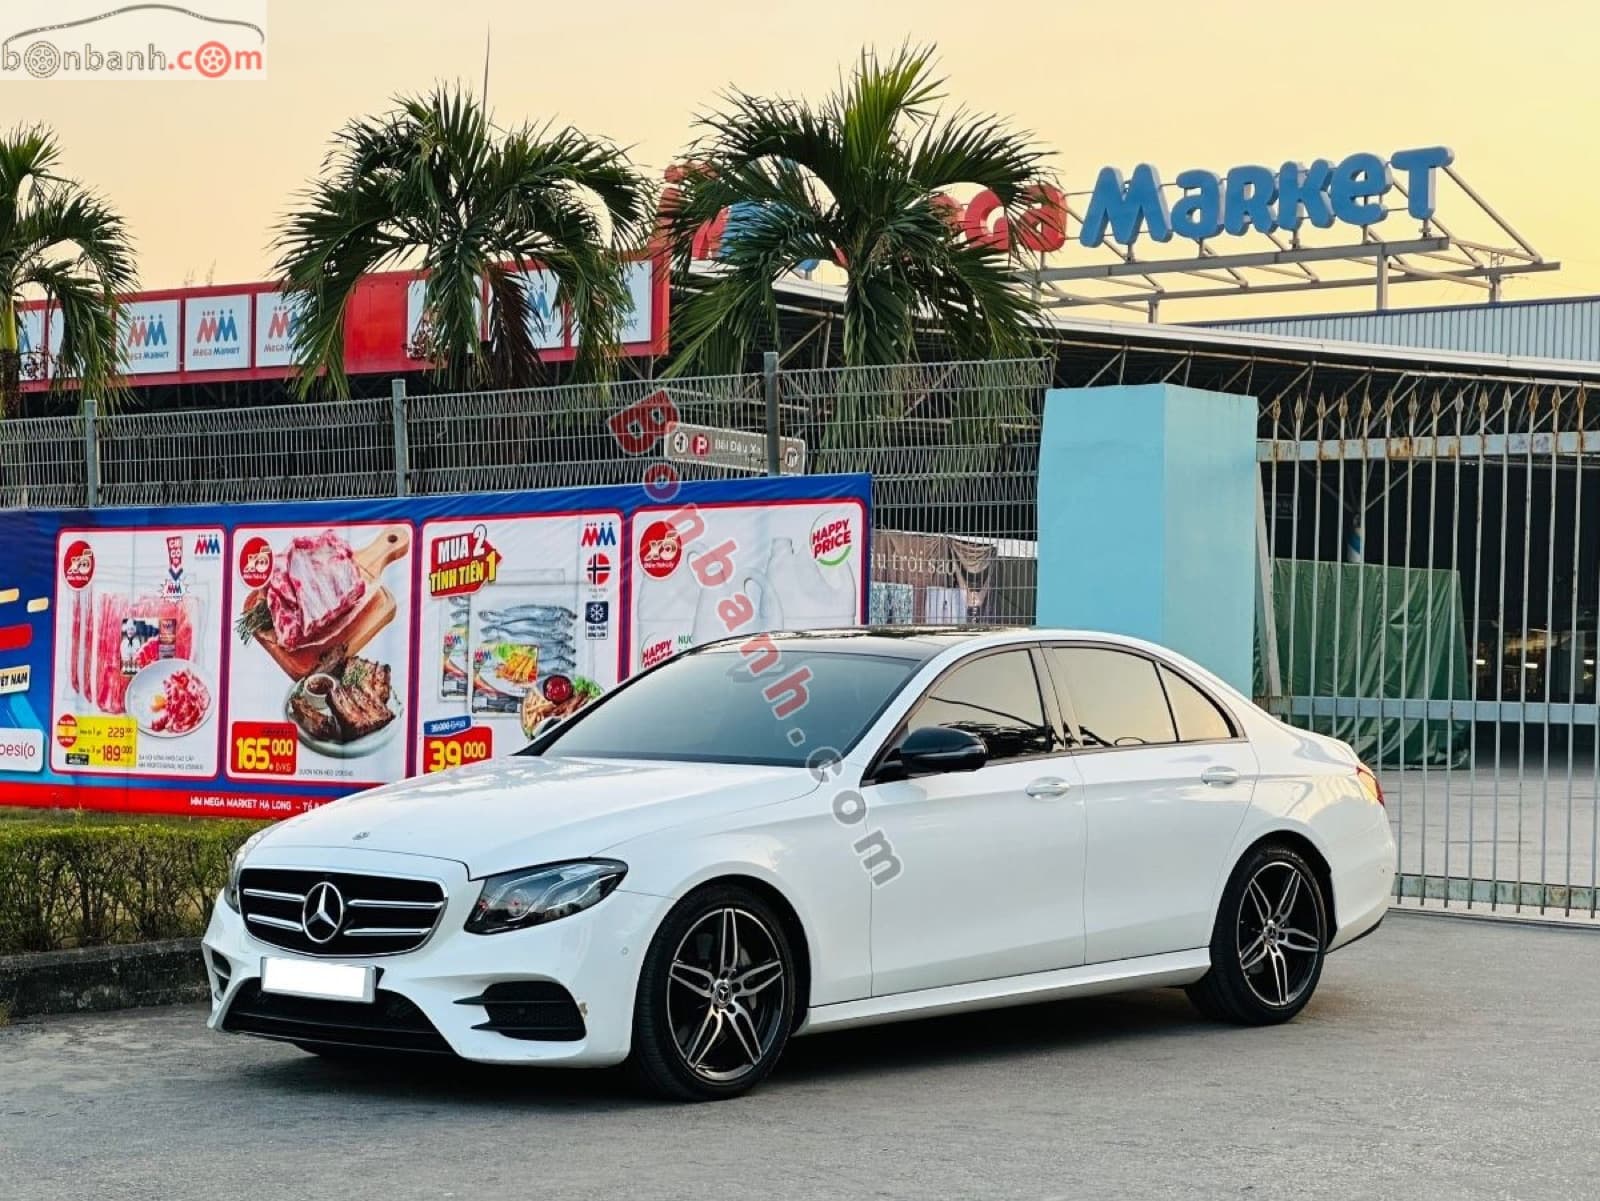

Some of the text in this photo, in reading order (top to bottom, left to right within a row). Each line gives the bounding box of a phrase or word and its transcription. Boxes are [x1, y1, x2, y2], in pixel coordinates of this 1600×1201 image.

[438, 524, 487, 564] MUA 2
[812, 518, 849, 545] HAPPY
[814, 531, 851, 559] PRICE
[429, 567, 457, 593] TÍNH
[486, 549, 497, 583] 1
[642, 640, 672, 661] HAPPY
[108, 728, 125, 738] 229
[102, 745, 121, 761] 189
[429, 740, 462, 773] 39
[203, 797, 225, 807] MEGA
[226, 798, 257, 809] MARKET
[271, 800, 292, 811] LONG
